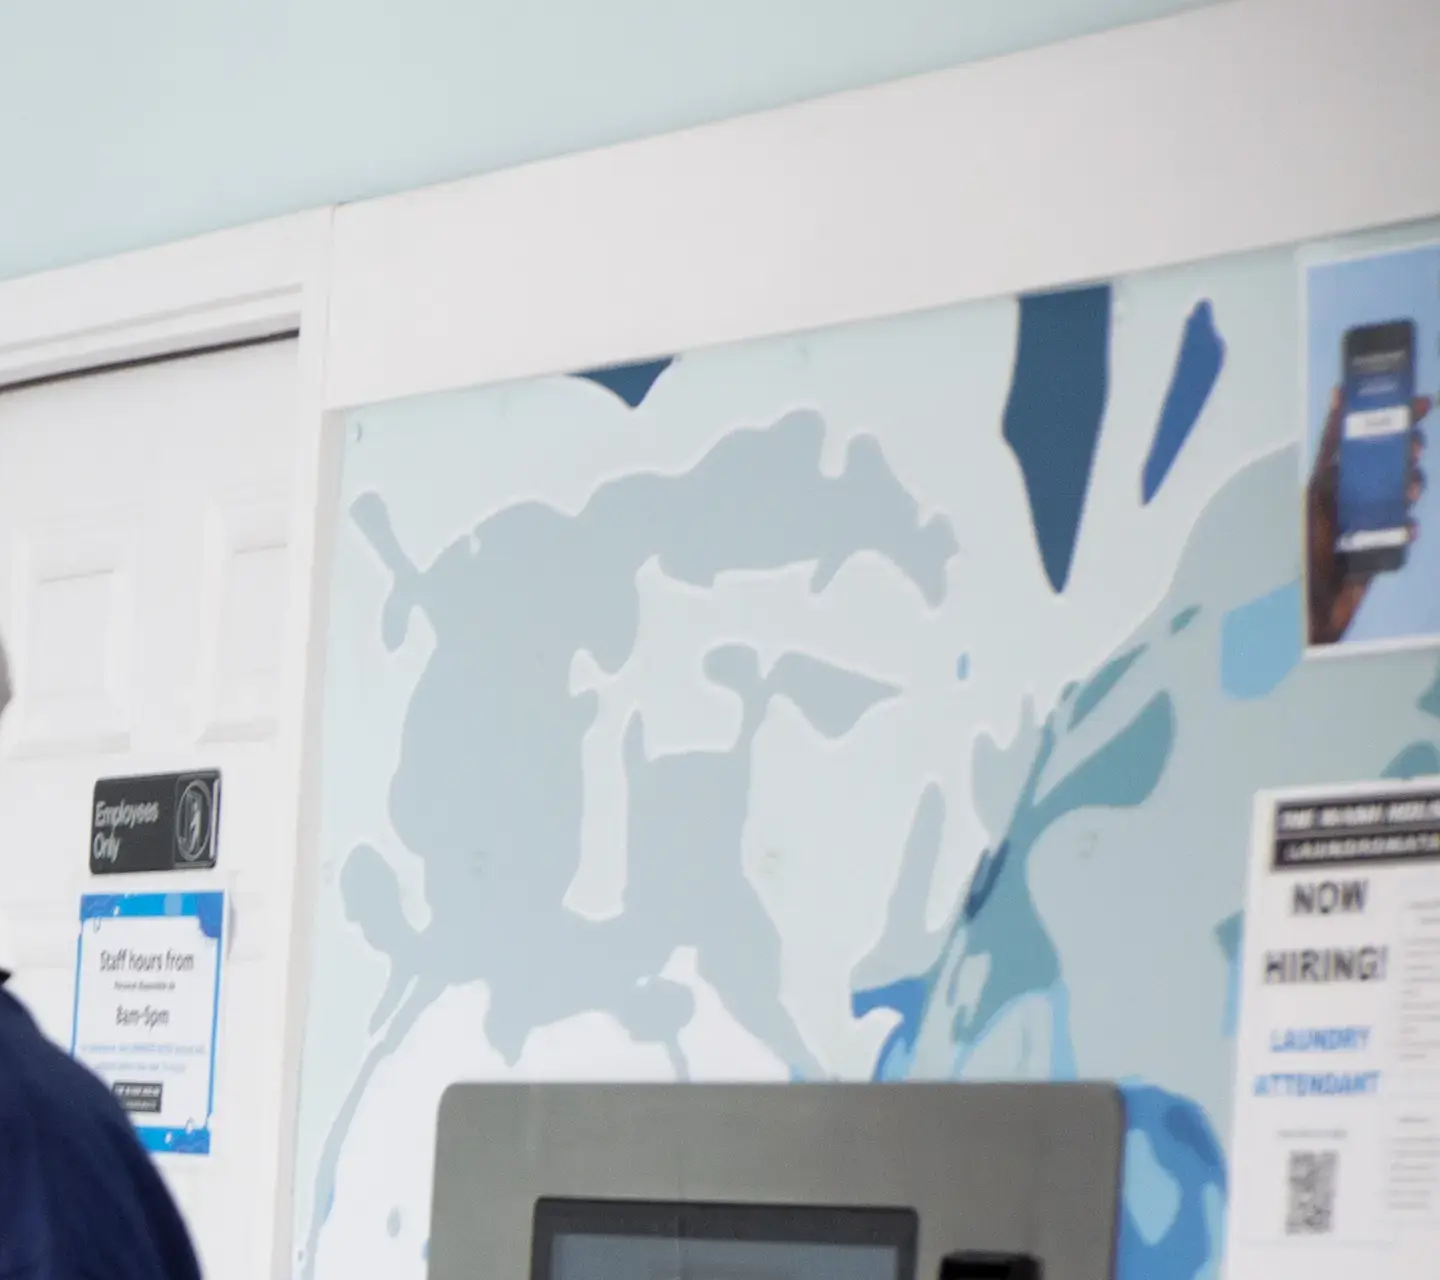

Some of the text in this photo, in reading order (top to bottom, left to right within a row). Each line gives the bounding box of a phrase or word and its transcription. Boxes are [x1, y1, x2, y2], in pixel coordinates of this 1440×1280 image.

[95, 799, 159, 829] Employees
[93, 831, 121, 863] Only
[1292, 877, 1369, 915] NOW
[100, 947, 194, 972] Staff hours from
[1264, 946, 1388, 984] HIRING!
[1270, 1026, 1372, 1052] LAUNDRY
